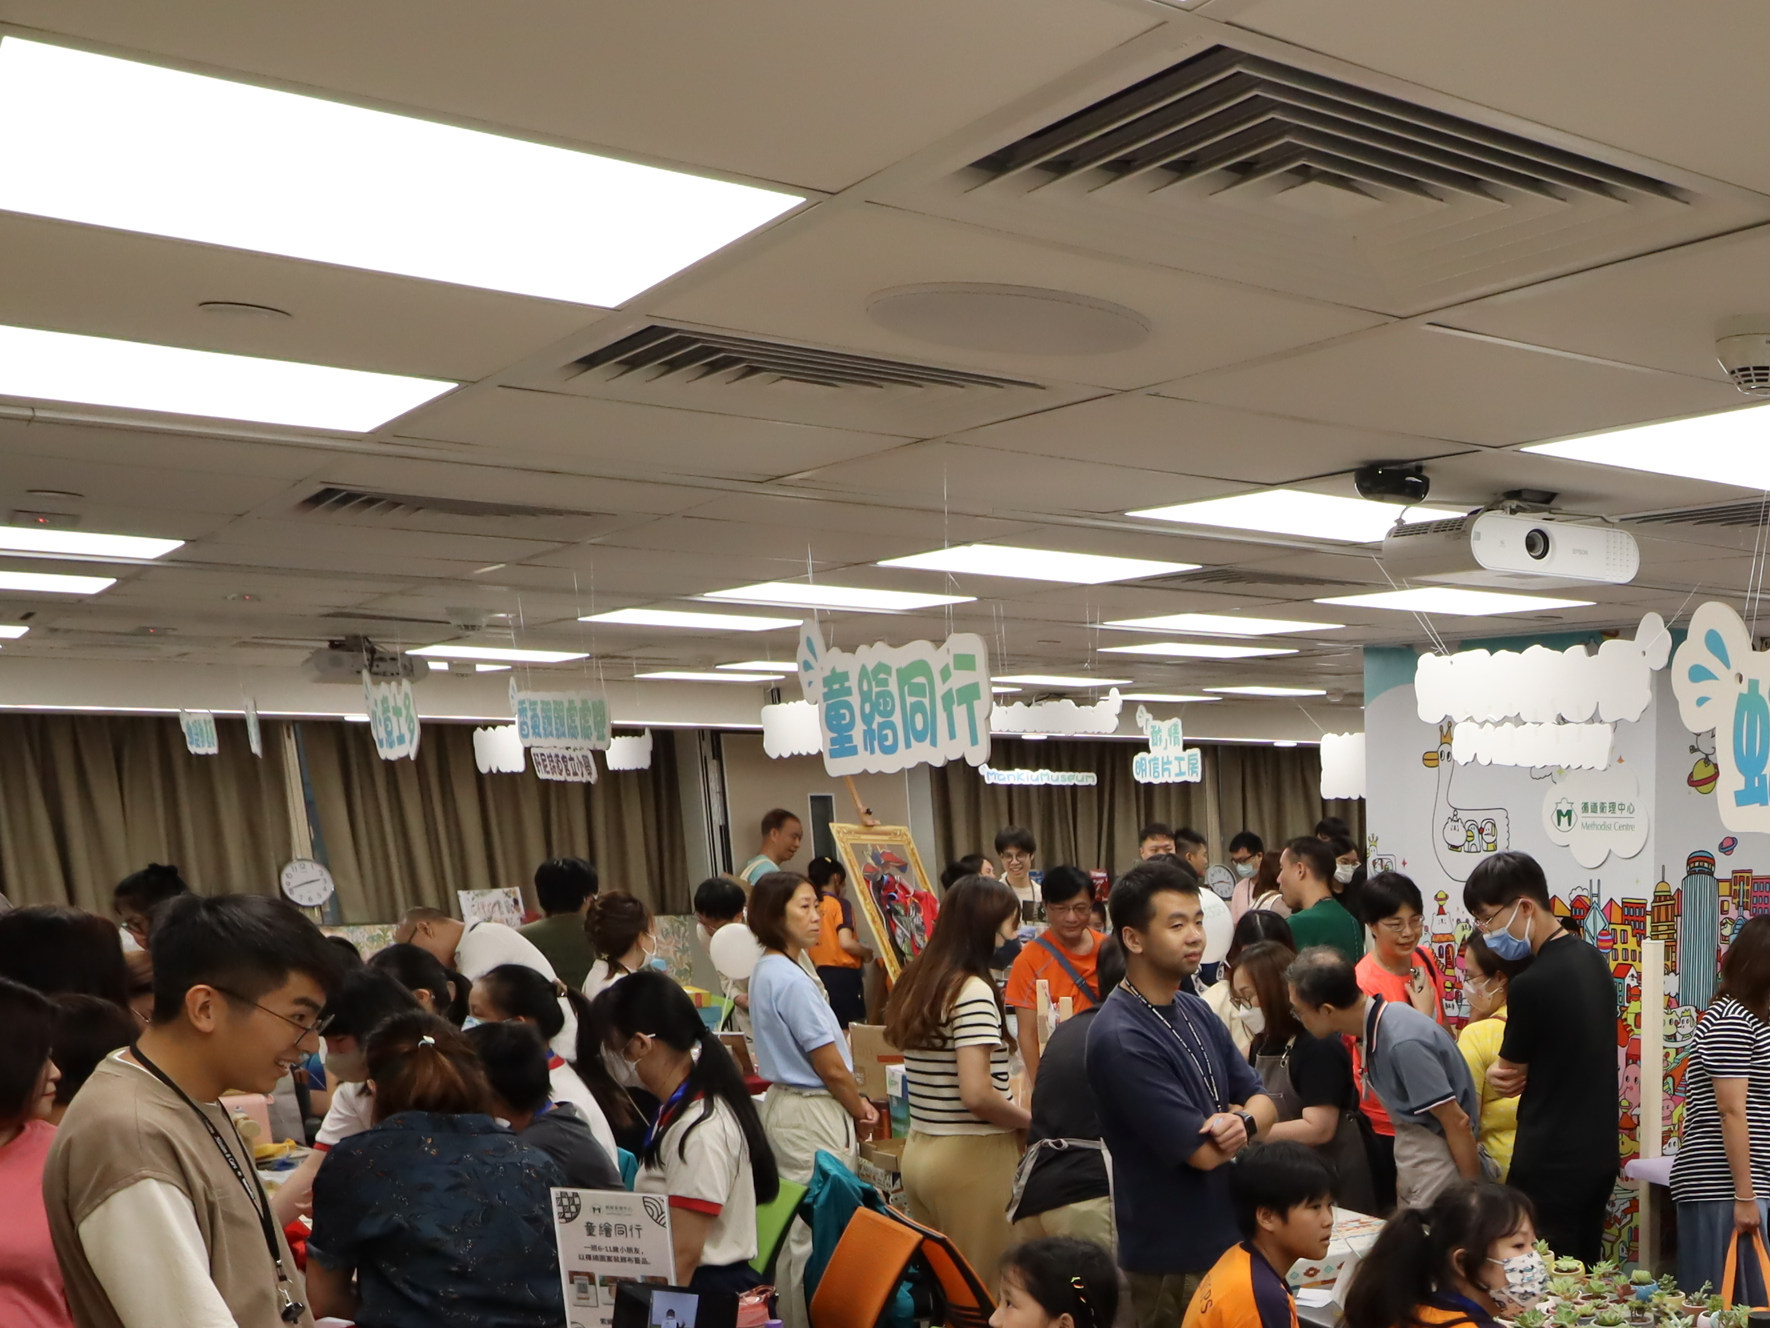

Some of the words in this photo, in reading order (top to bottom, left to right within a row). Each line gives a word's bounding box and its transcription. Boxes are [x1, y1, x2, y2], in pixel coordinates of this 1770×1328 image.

[822, 653, 982, 759] 童繪同行
[371, 692, 415, 749] 心意士多
[1135, 753, 1199, 778] 明信片工房
[1581, 822, 1612, 831] Methodist
[1613, 822, 1635, 831] Centre
[584, 1221, 642, 1239] 童繪同行
